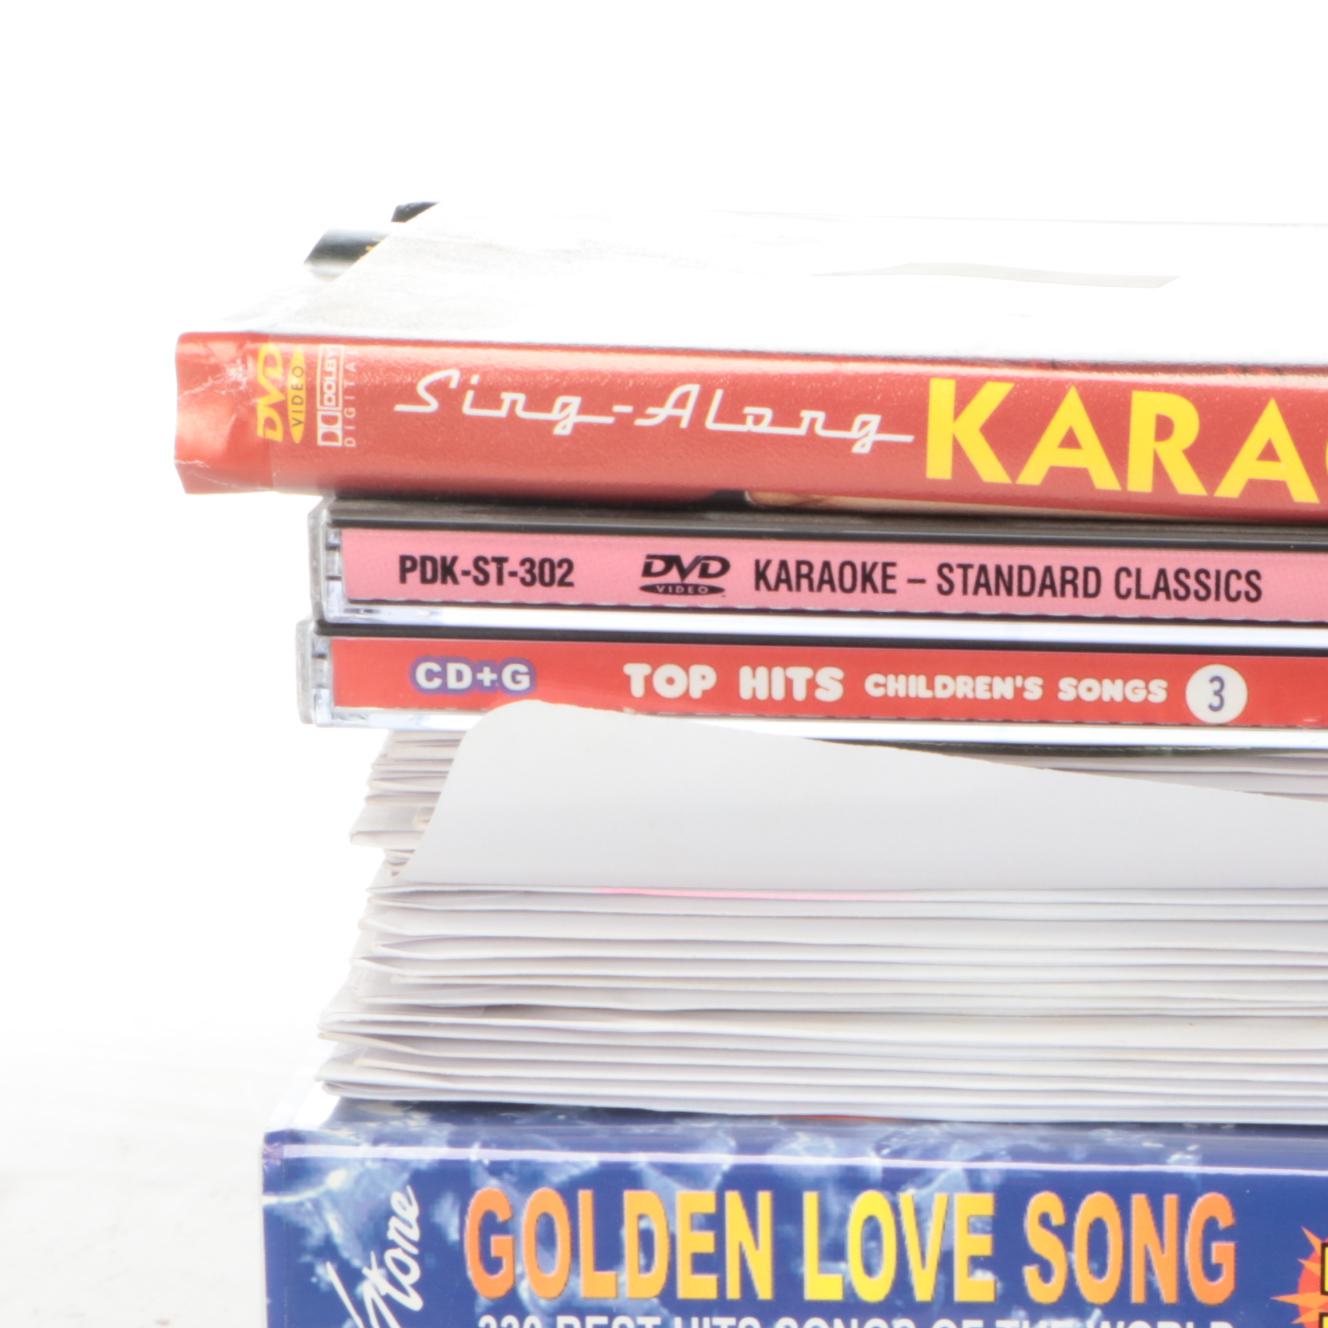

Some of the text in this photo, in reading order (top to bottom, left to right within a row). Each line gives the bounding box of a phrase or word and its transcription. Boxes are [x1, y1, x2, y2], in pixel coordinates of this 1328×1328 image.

[256, 343, 287, 443] DVD
[291, 366, 305, 428] VIDEO
[394, 369, 914, 453] Sing-Along
[399, 555, 575, 589] PDK-ST-302
[641, 554, 731, 581] DVD
[655, 584, 710, 595] VIDEO
[753, 558, 898, 595] KARAOKE
[935, 562, 1103, 600] STANDARD
[1114, 565, 1264, 604] CLASSICS
[415, 661, 532, 692] CD+G
[622, 661, 1228, 711] TOP HITS CHILDREN'S SONGS 3
[463, 1186, 1237, 1306] GOLDEN LOVE SONG
